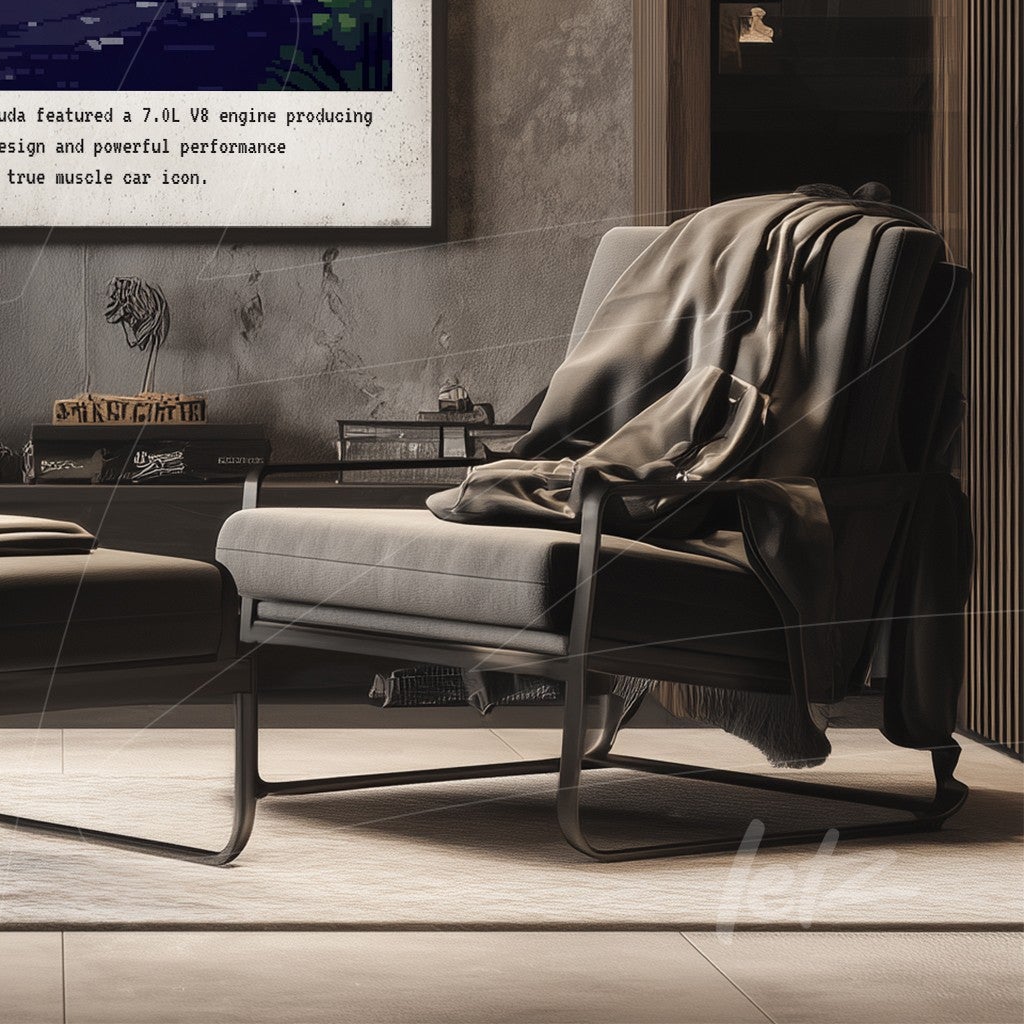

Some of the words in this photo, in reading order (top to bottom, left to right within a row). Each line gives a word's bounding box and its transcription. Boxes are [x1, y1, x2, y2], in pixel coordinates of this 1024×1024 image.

[37, 107, 113, 123] featured
[122, 111, 132, 123] a
[142, 107, 180, 123] 7.0L
[190, 107, 209, 123] V8
[219, 107, 276, 127] engine
[286, 107, 373, 127] producing
[55, 138, 84, 154] and
[93, 138, 170, 158] powerful
[180, 138, 286, 158] performance
[7, 169, 45, 185] true
[55, 169, 113, 185] muscle
[122, 173, 152, 185] car
[162, 169, 208, 185] icon.
